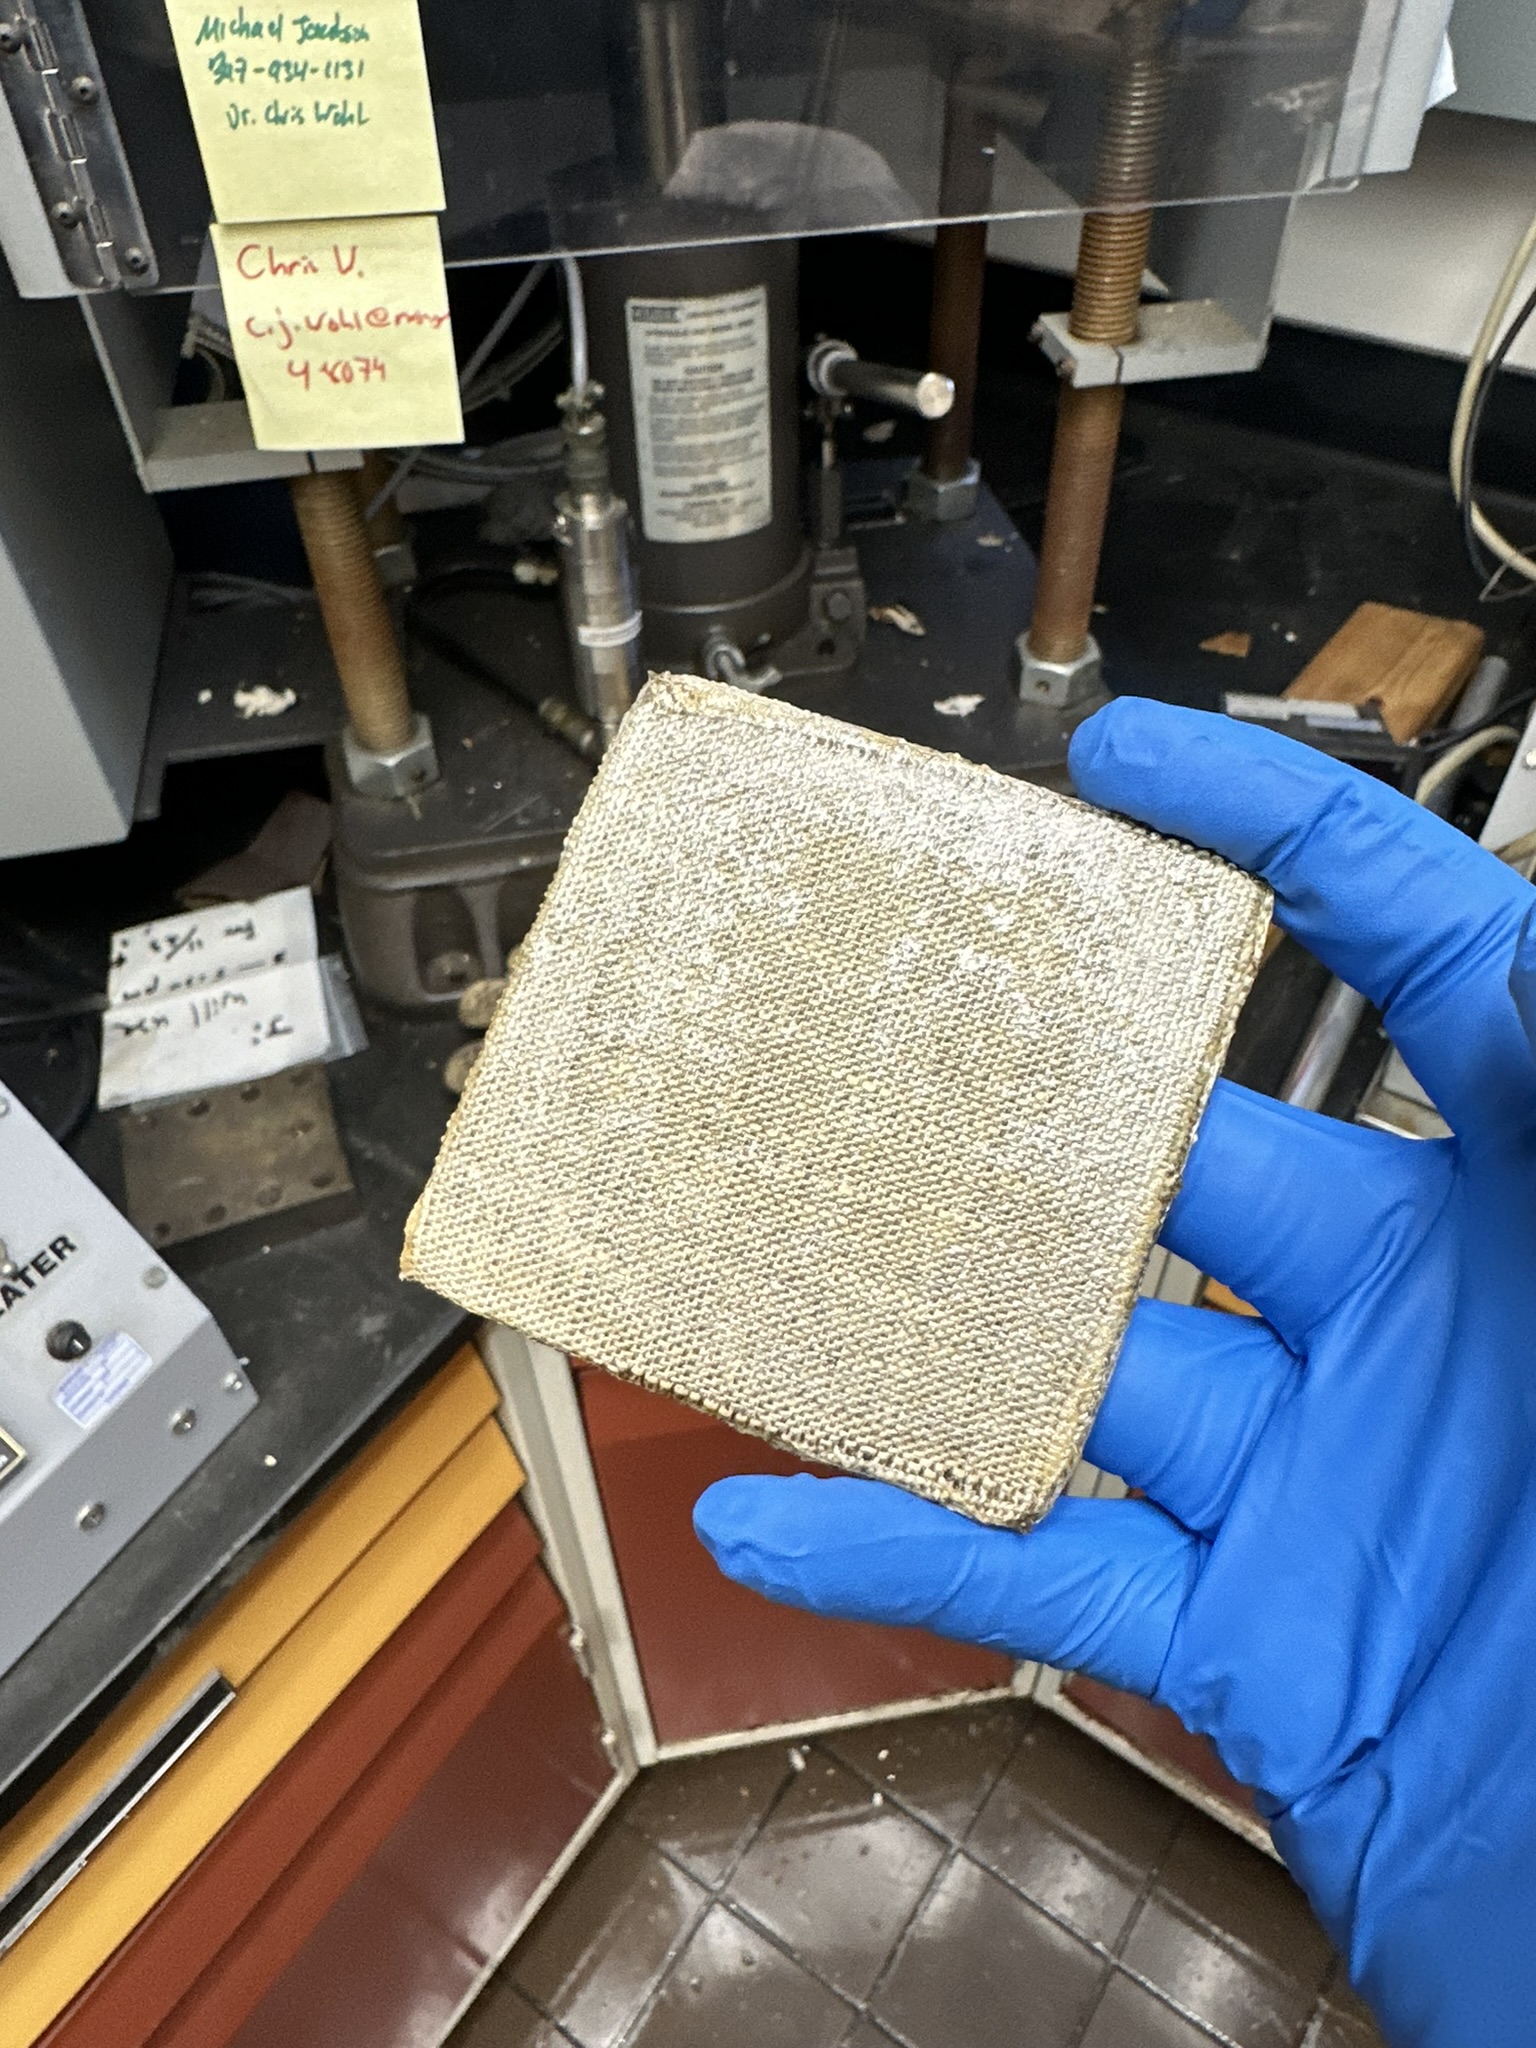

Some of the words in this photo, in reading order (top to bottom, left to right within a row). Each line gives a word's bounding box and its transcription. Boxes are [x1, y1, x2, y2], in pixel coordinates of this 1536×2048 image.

[195, 6, 284, 46] Michael
[264, 99, 305, 125] Chris
[0, 1234, 77, 1317] ATER
